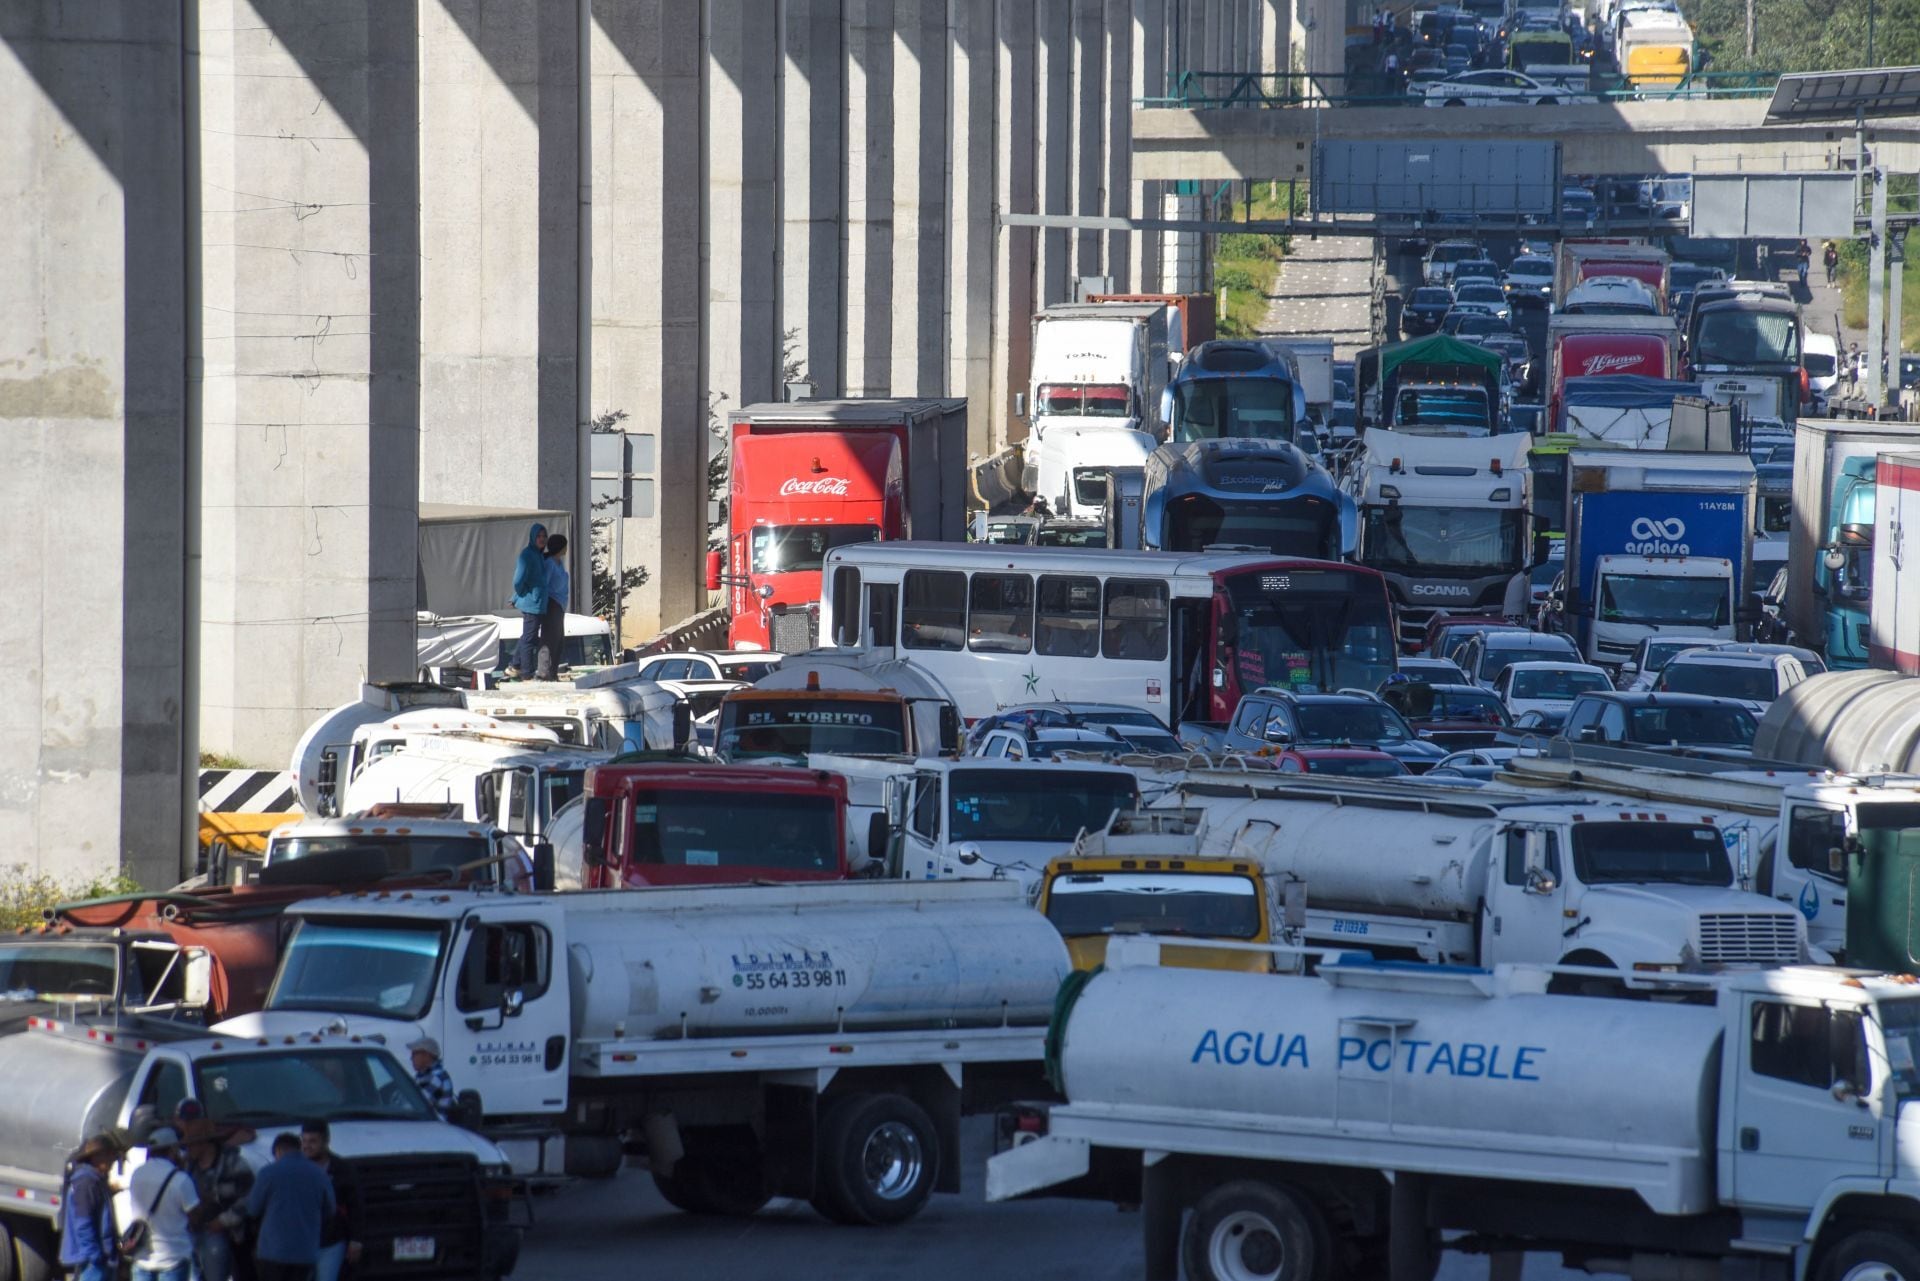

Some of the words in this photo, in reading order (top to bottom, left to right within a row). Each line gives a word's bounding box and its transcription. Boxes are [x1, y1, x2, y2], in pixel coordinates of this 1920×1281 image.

[1699, 502, 1736, 511] 11AY8M
[1625, 540, 1690, 555] arplasa
[1412, 584, 1471, 596] SCANIA
[748, 712, 775, 724] EL
[788, 711, 873, 725] TORITO
[746, 972, 766, 990] 55
[769, 971, 788, 988] 64
[791, 970, 811, 988] 33
[813, 970, 833, 987] 98
[835, 969, 847, 986] 11
[1191, 1029, 1310, 1068] AGUA
[1337, 1036, 1547, 1081] POTABLE
